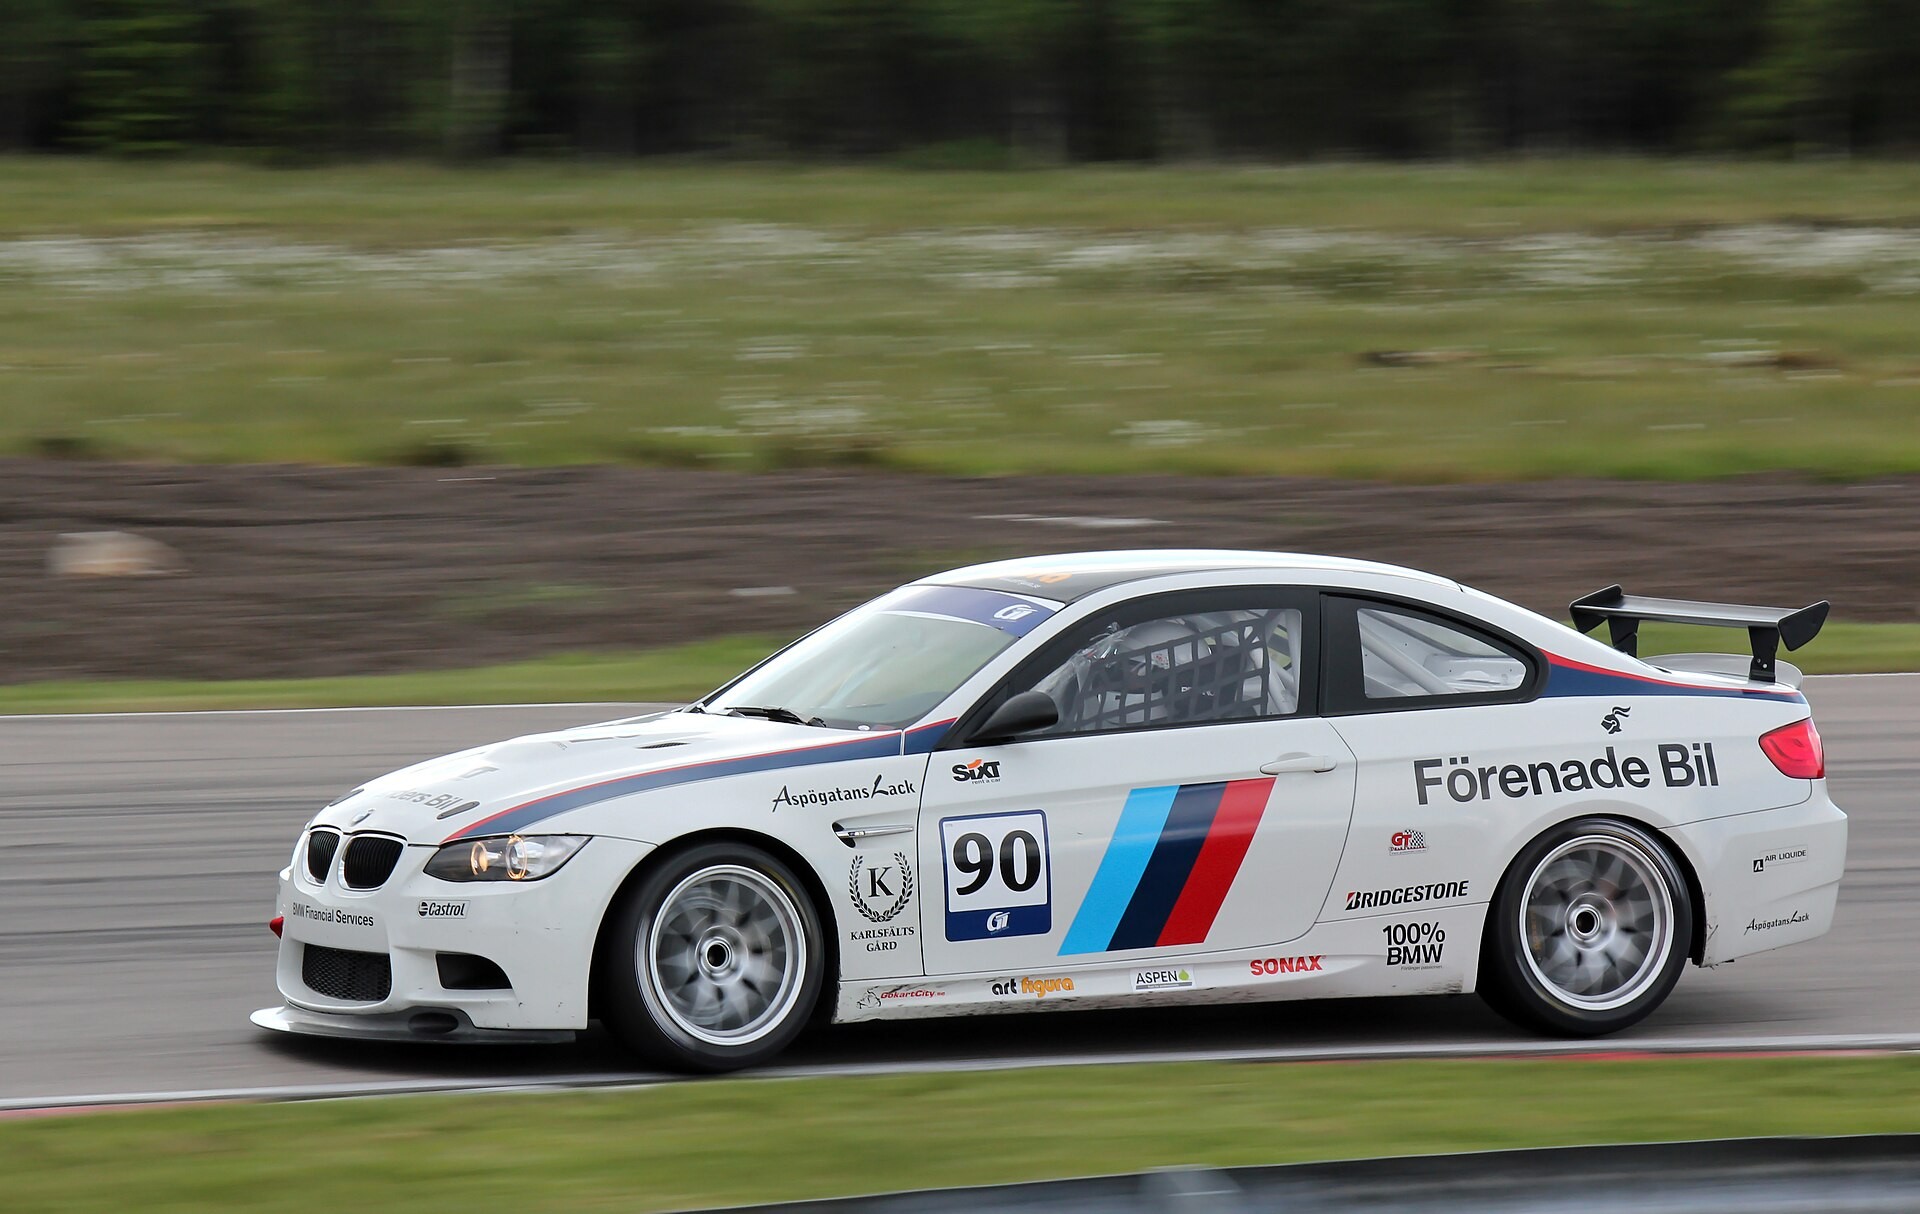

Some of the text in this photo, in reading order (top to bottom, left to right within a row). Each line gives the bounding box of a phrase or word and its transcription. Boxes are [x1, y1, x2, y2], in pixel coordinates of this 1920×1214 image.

[1413, 742, 1719, 805] Förenade Bil
[1391, 832, 1412, 848] GT
[952, 829, 1042, 896] 90
[1764, 850, 1806, 862] AIR LIQUIDE
[867, 866, 894, 898] K
[1345, 880, 1469, 911] BRIDGESTONE
[292, 902, 374, 926] BMW Financial Services
[428, 902, 466, 917] Castrol
[850, 925, 915, 941] KARLSFÄLTS
[1382, 921, 1446, 946] 100%
[866, 939, 898, 953] GÅRD
[1386, 943, 1444, 966] BMW
[1136, 970, 1178, 984] ASPEN
[1250, 955, 1323, 976] SONAX
[991, 976, 1075, 999] art figura
